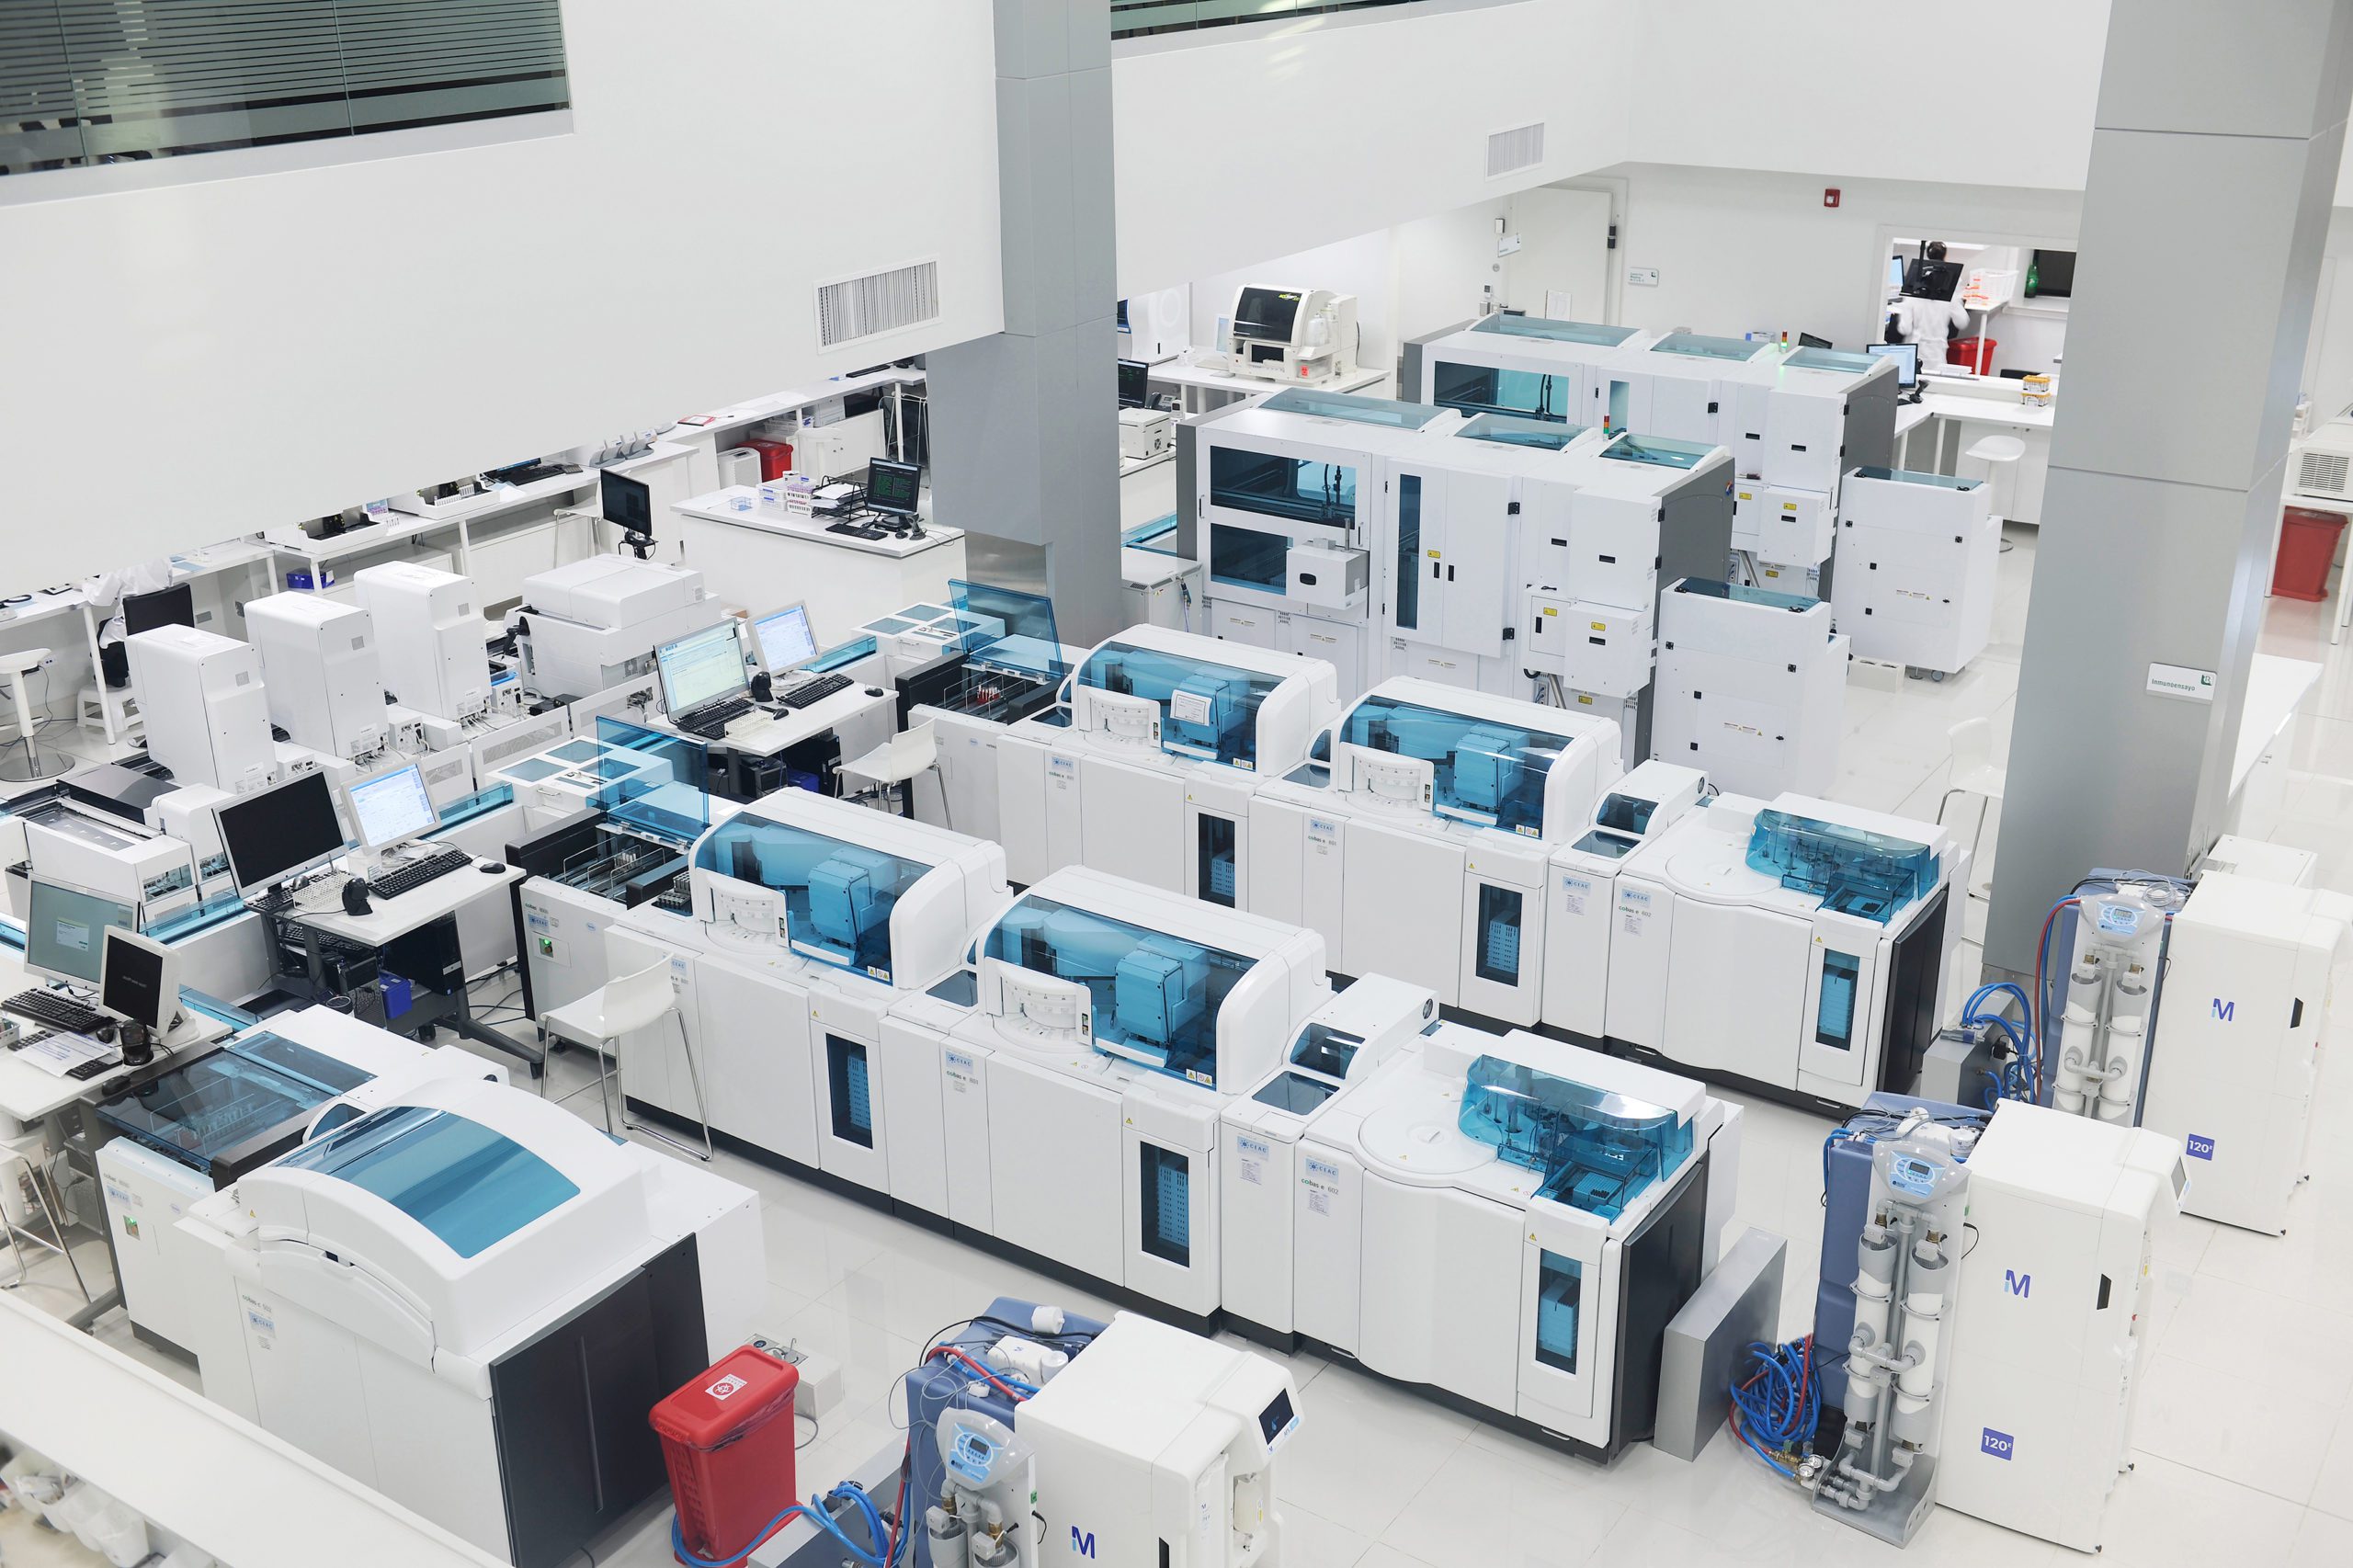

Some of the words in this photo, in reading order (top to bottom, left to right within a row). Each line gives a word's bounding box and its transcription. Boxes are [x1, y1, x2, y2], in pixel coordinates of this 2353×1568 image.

[2151, 678, 2196, 691] Inmunoensayo
[1618, 905, 1635, 914] cobas
[1249, 1142, 1267, 1153] CEAC
[1318, 1165, 1336, 1176] CEAC
[1301, 1177, 1320, 1188] cobas
[1327, 1187, 1339, 1196] 602
